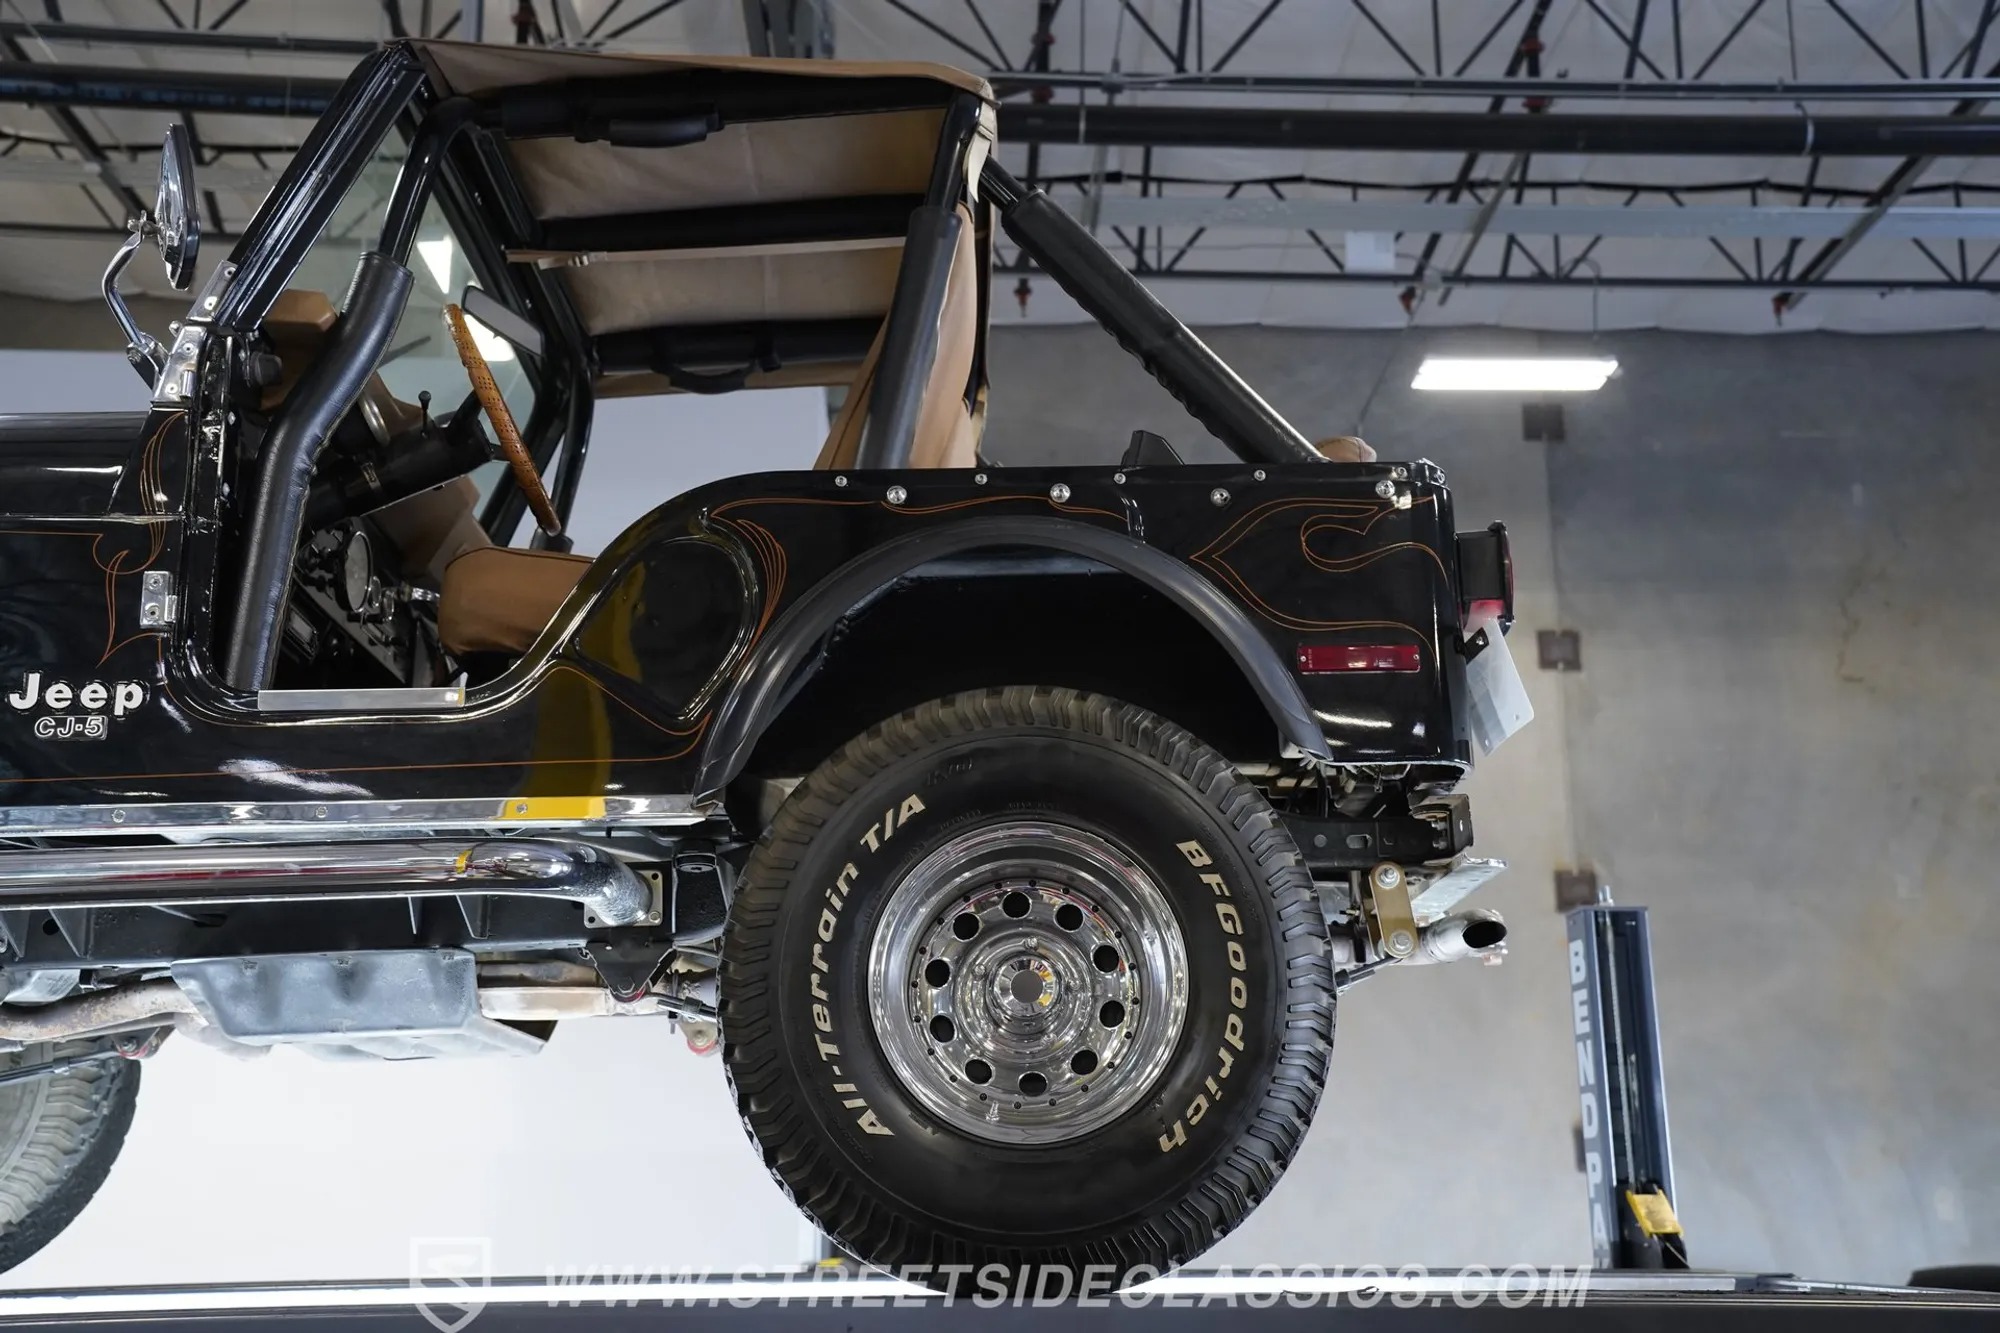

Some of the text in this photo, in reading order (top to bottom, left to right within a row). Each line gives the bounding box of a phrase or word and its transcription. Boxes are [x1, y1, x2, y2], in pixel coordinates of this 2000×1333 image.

[9, 672, 145, 717] Jeep
[34, 716, 106, 738] CJ-5
[810, 862, 896, 1136] All-Terrain
[859, 793, 927, 853] T/A
[1159, 839, 1248, 1152] BFGoodrich
